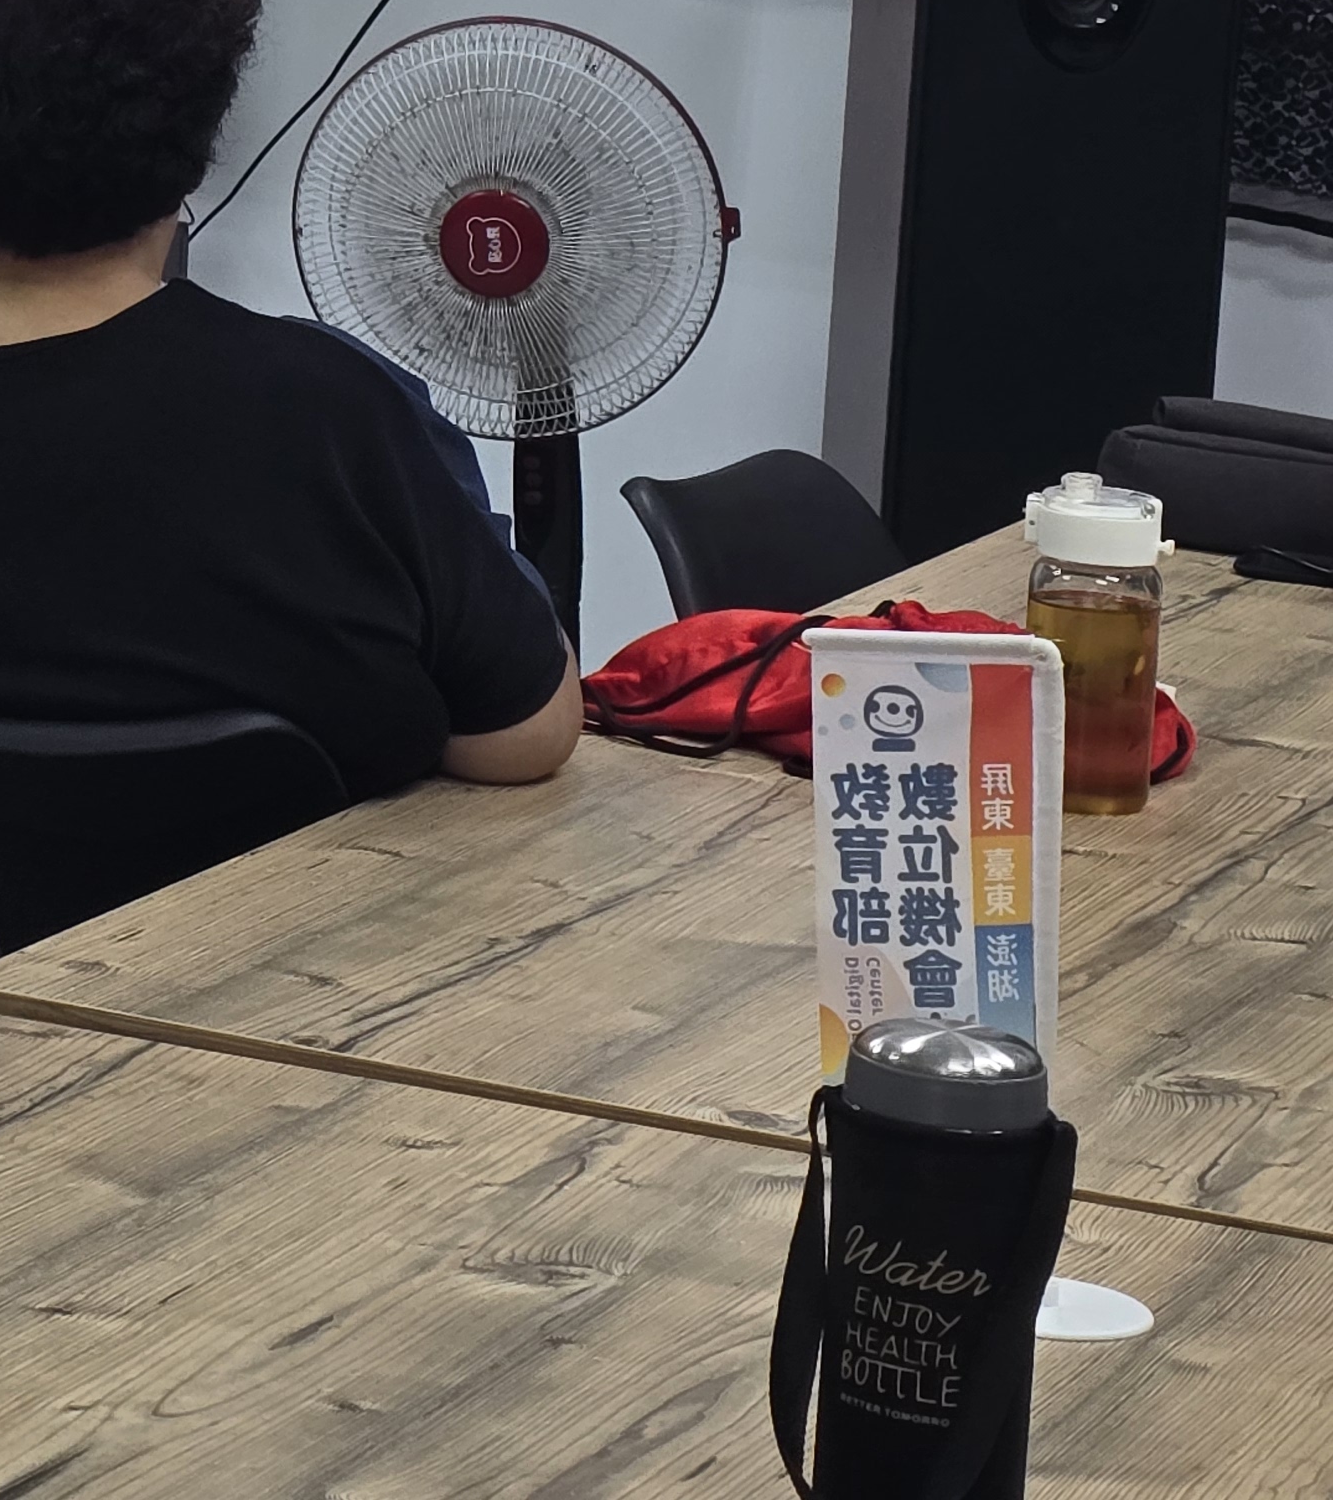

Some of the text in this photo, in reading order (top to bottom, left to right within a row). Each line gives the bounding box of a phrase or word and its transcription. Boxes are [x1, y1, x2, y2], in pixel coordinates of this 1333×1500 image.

[844, 1225, 992, 1297] Water
[854, 1286, 962, 1337] ENJOY
[846, 1321, 958, 1370] HEALTH
[840, 1349, 963, 1407] BOTTLE
[840, 1392, 881, 1415] BETTER
